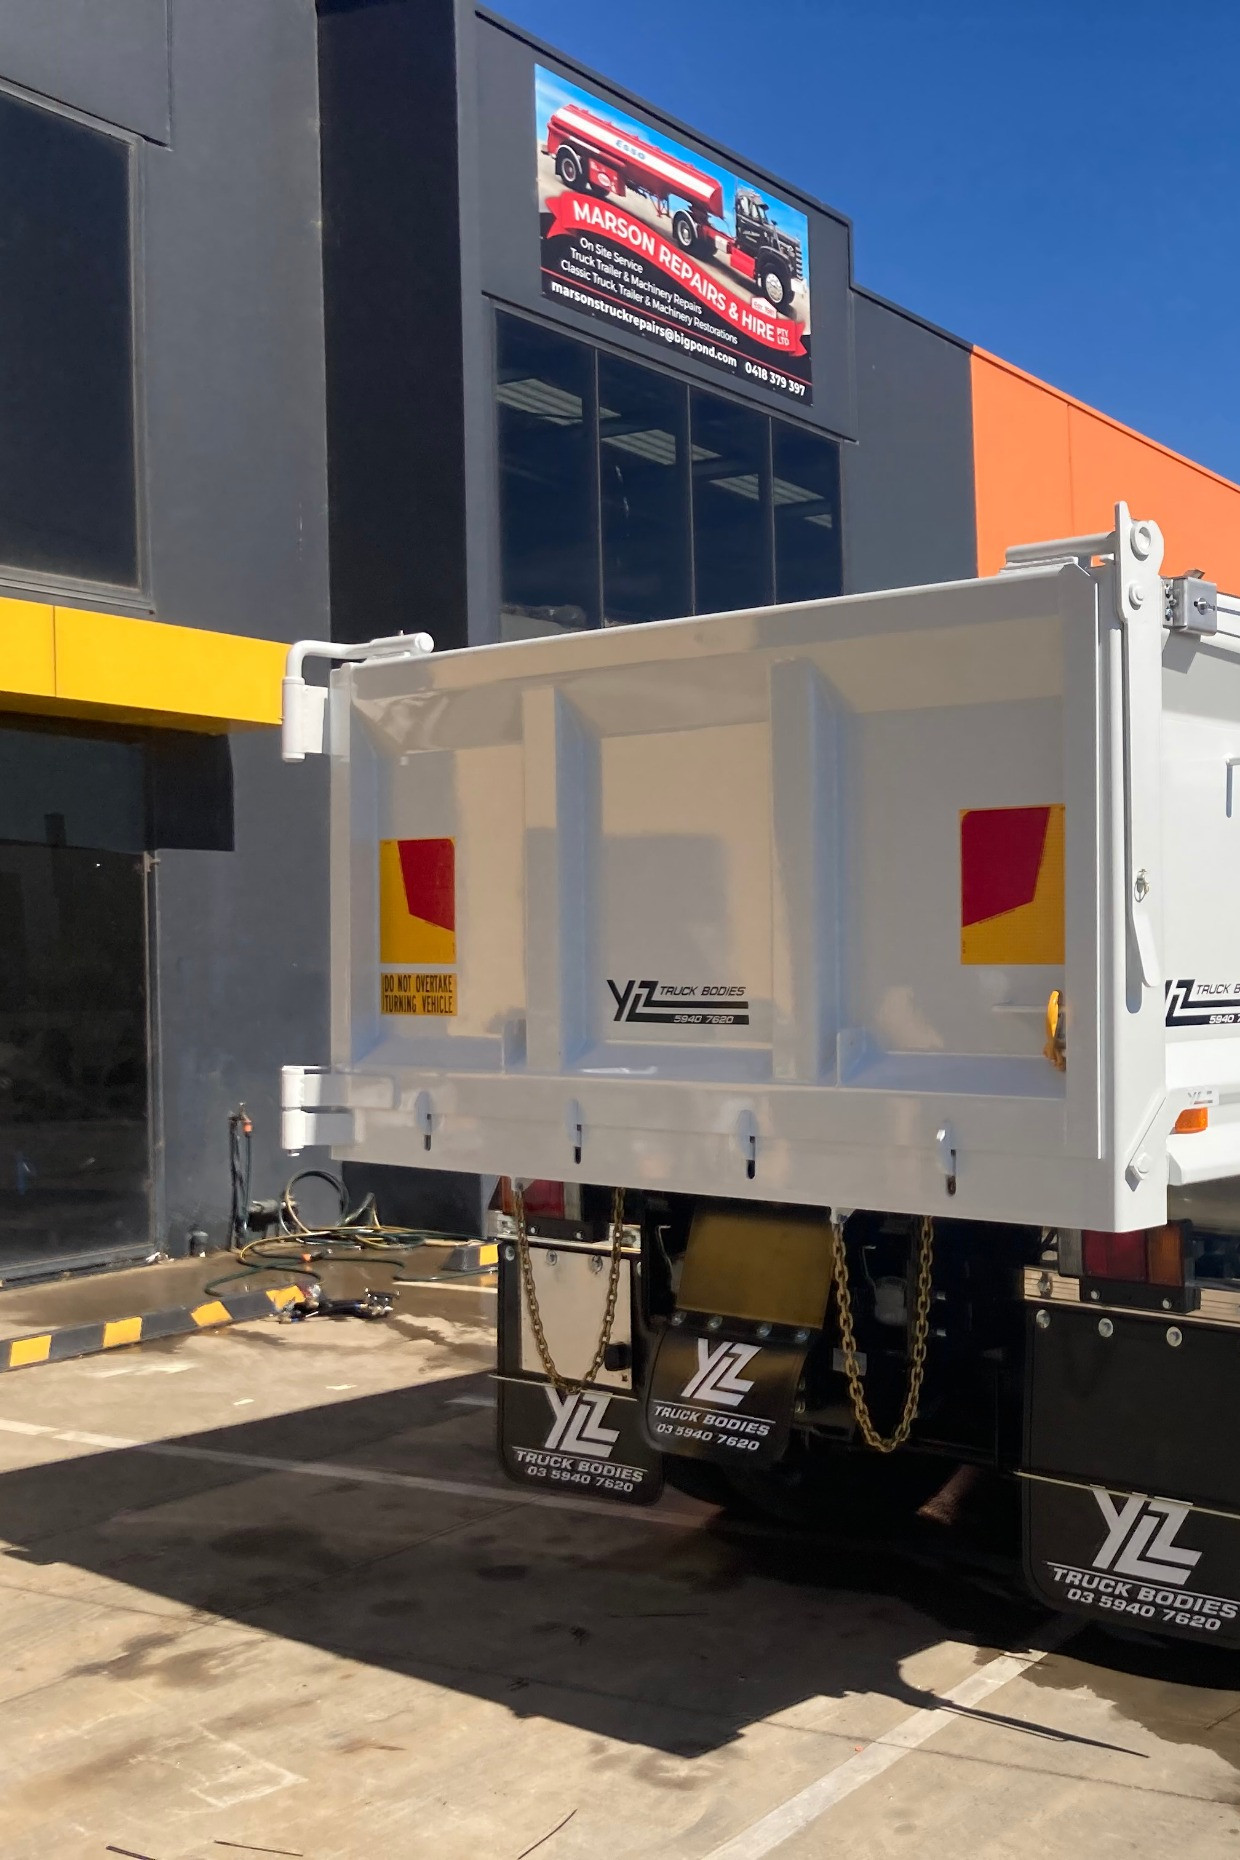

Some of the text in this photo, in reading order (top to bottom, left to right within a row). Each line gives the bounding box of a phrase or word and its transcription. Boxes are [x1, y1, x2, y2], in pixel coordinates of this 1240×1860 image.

[580, 237, 644, 274] On Site Service
[570, 247, 702, 315] Truck Trailer & Machinery Repairs
[573, 200, 775, 342] MARSON REPAIRS & HIRE
[561, 260, 591, 281] Classic
[619, 283, 644, 303] Trailer
[645, 296, 651, 307] &
[652, 300, 693, 326] Machinery
[693, 317, 738, 345] Restorations
[551, 281, 806, 397] marsonstruckrepairs@bigpond.com 0418 379 397
[777, 327, 789, 338] PTY
[777, 337, 790, 346] LTD
[384, 975, 452, 993] DO NOT OVERTAKE
[660, 986, 746, 997] TRUCK BODIES
[1196, 984, 1231, 995] TRUCK
[384, 995, 453, 1013] TURNING VEHICLE
[673, 1015, 734, 1024] 5940 7620
[1209, 1014, 1235, 1024] 5940
[654, 1405, 770, 1437] TRUCK BODIES
[656, 1423, 761, 1451] 03 5940 7620
[516, 1450, 643, 1483] TRUCK BODIES
[527, 1466, 634, 1493] 03 5940 7620
[1053, 1567, 1239, 1619] TRUCK BODIES
[1066, 1588, 1222, 1632] 03 5940 7620
